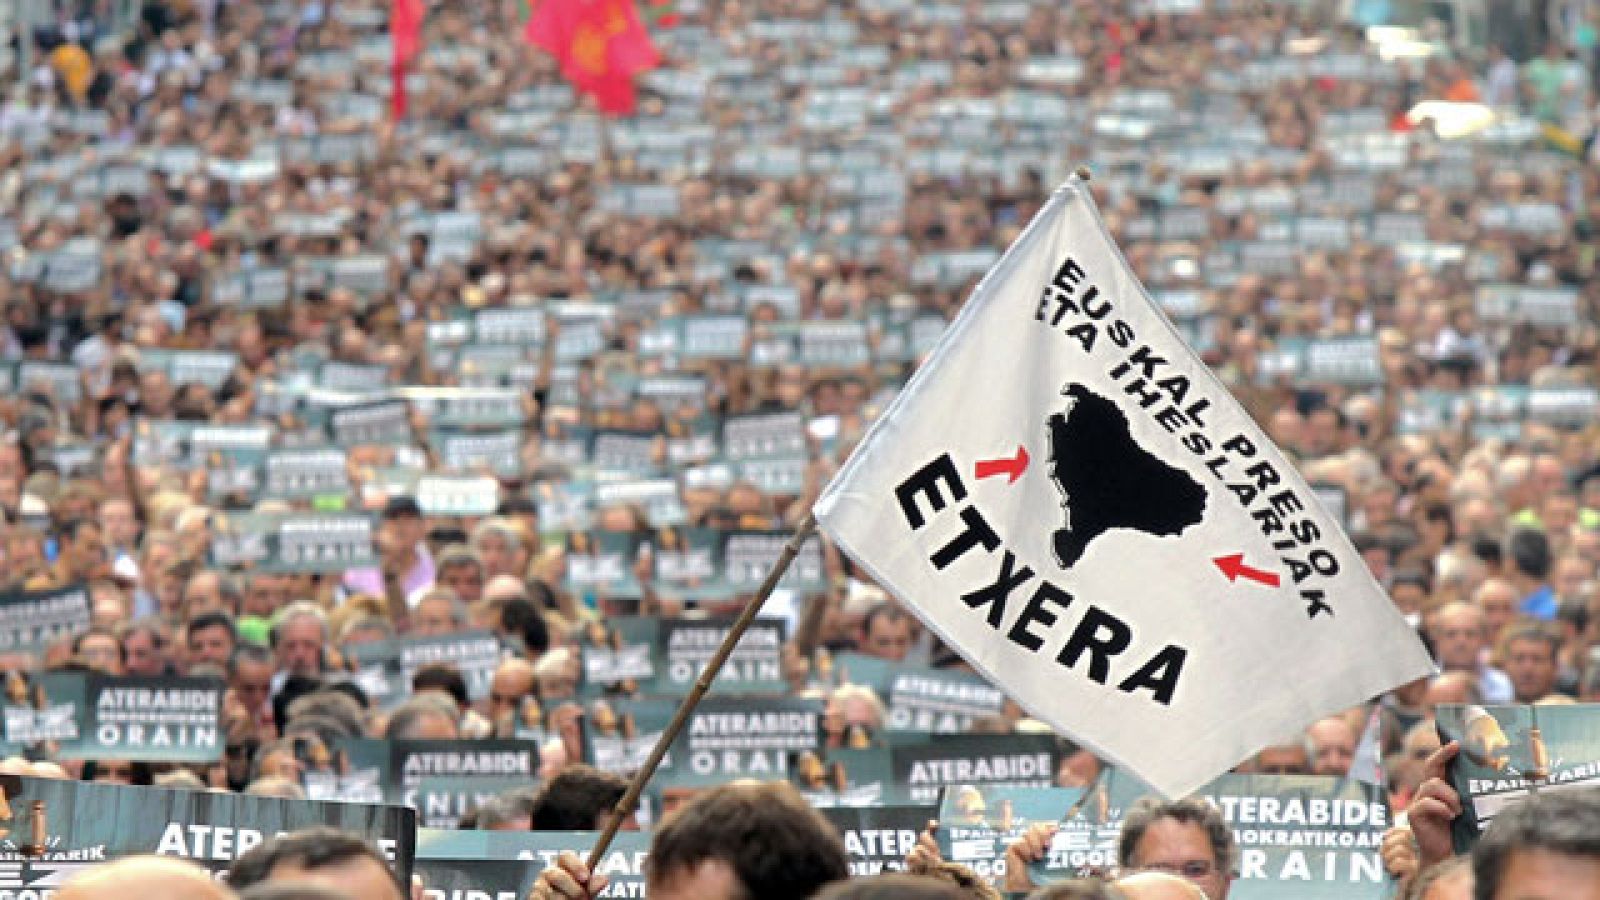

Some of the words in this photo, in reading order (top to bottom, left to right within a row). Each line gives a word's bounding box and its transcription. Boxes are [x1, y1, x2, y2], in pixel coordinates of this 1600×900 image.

[1052, 257, 1210, 428] EUSKAL
[1221, 433, 1340, 577] PRESO
[1035, 286, 1098, 353] ETA
[1109, 361, 1335, 619] IHESLARIAK
[894, 452, 1188, 706] ETXERA
[99, 687, 218, 708] ATERABIDE
[99, 724, 217, 747] ORAIN
[690, 713, 817, 736] ATERABIDE
[403, 752, 531, 774] ATERABIDE
[690, 751, 788, 774] ORAI
[910, 753, 1052, 784] ATERABIDE
[844, 829, 916, 856] ATER
[1241, 849, 1384, 883] RAIN
